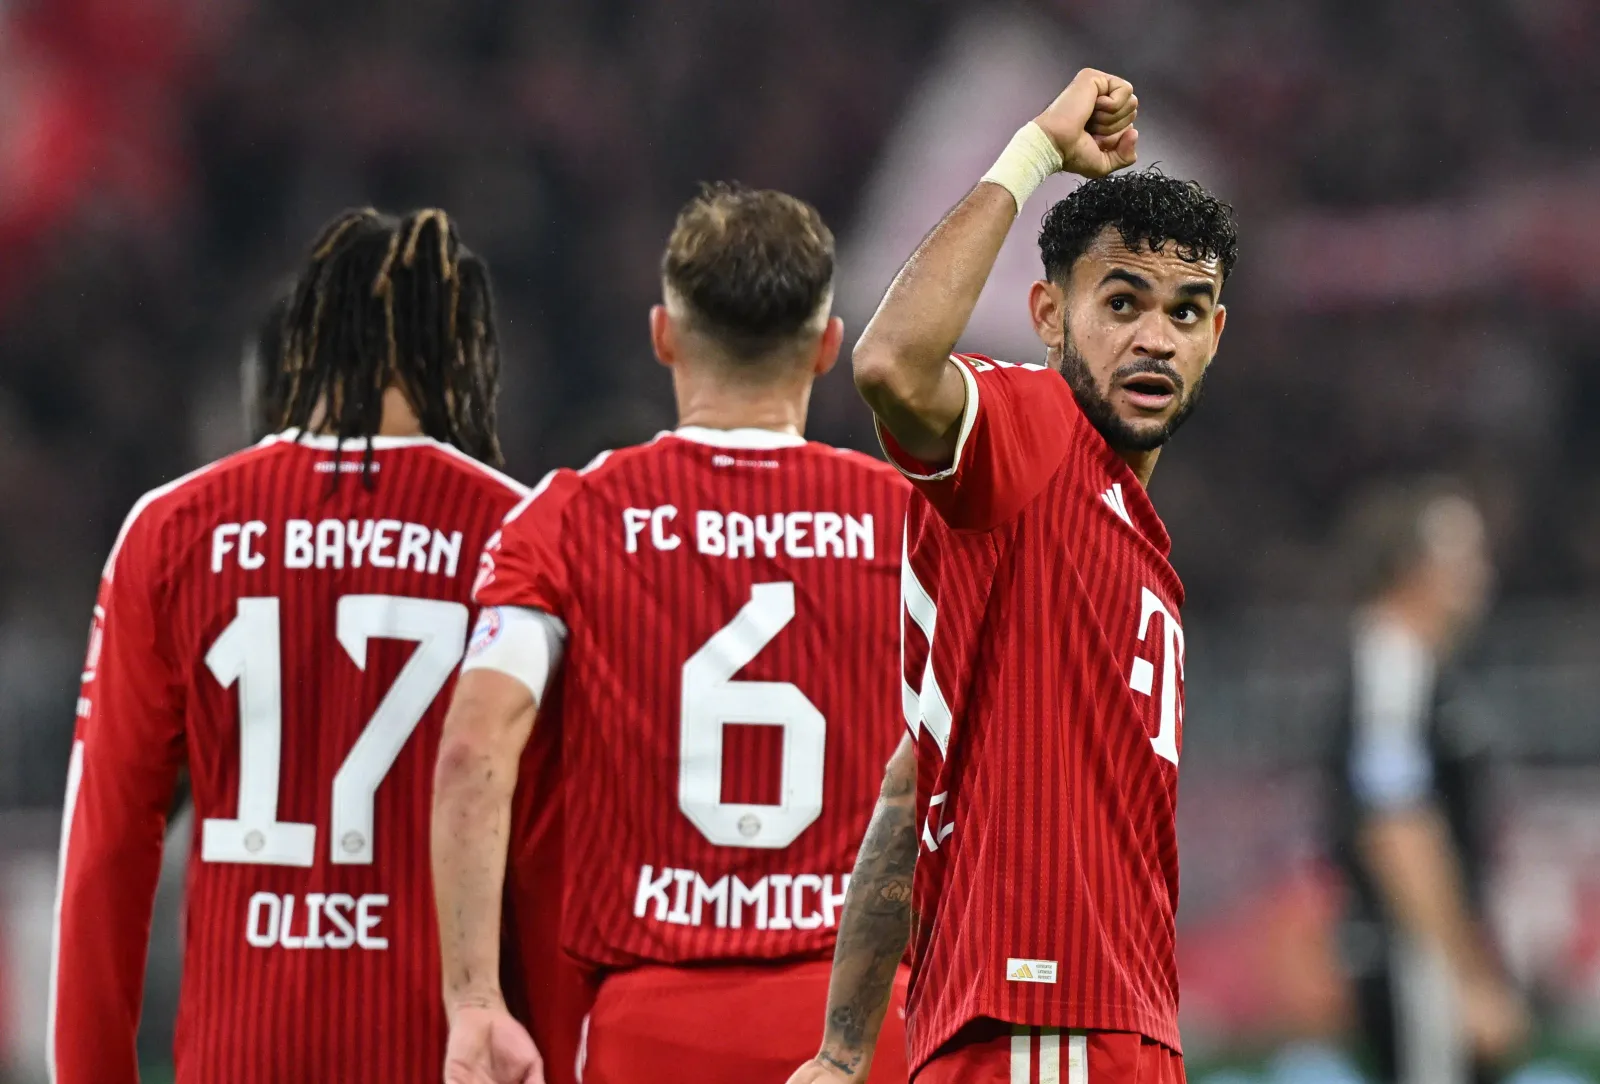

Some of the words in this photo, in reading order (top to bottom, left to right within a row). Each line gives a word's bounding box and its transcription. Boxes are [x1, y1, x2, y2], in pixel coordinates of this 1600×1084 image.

[211, 520, 268, 573] FC
[284, 518, 463, 577] BAYERN
[623, 504, 682, 554] FC
[696, 510, 875, 561] BAYERN
[201, 594, 470, 867] 17
[678, 581, 827, 849] 6
[246, 891, 389, 949] OLISE
[633, 864, 852, 931] KIMMICH
